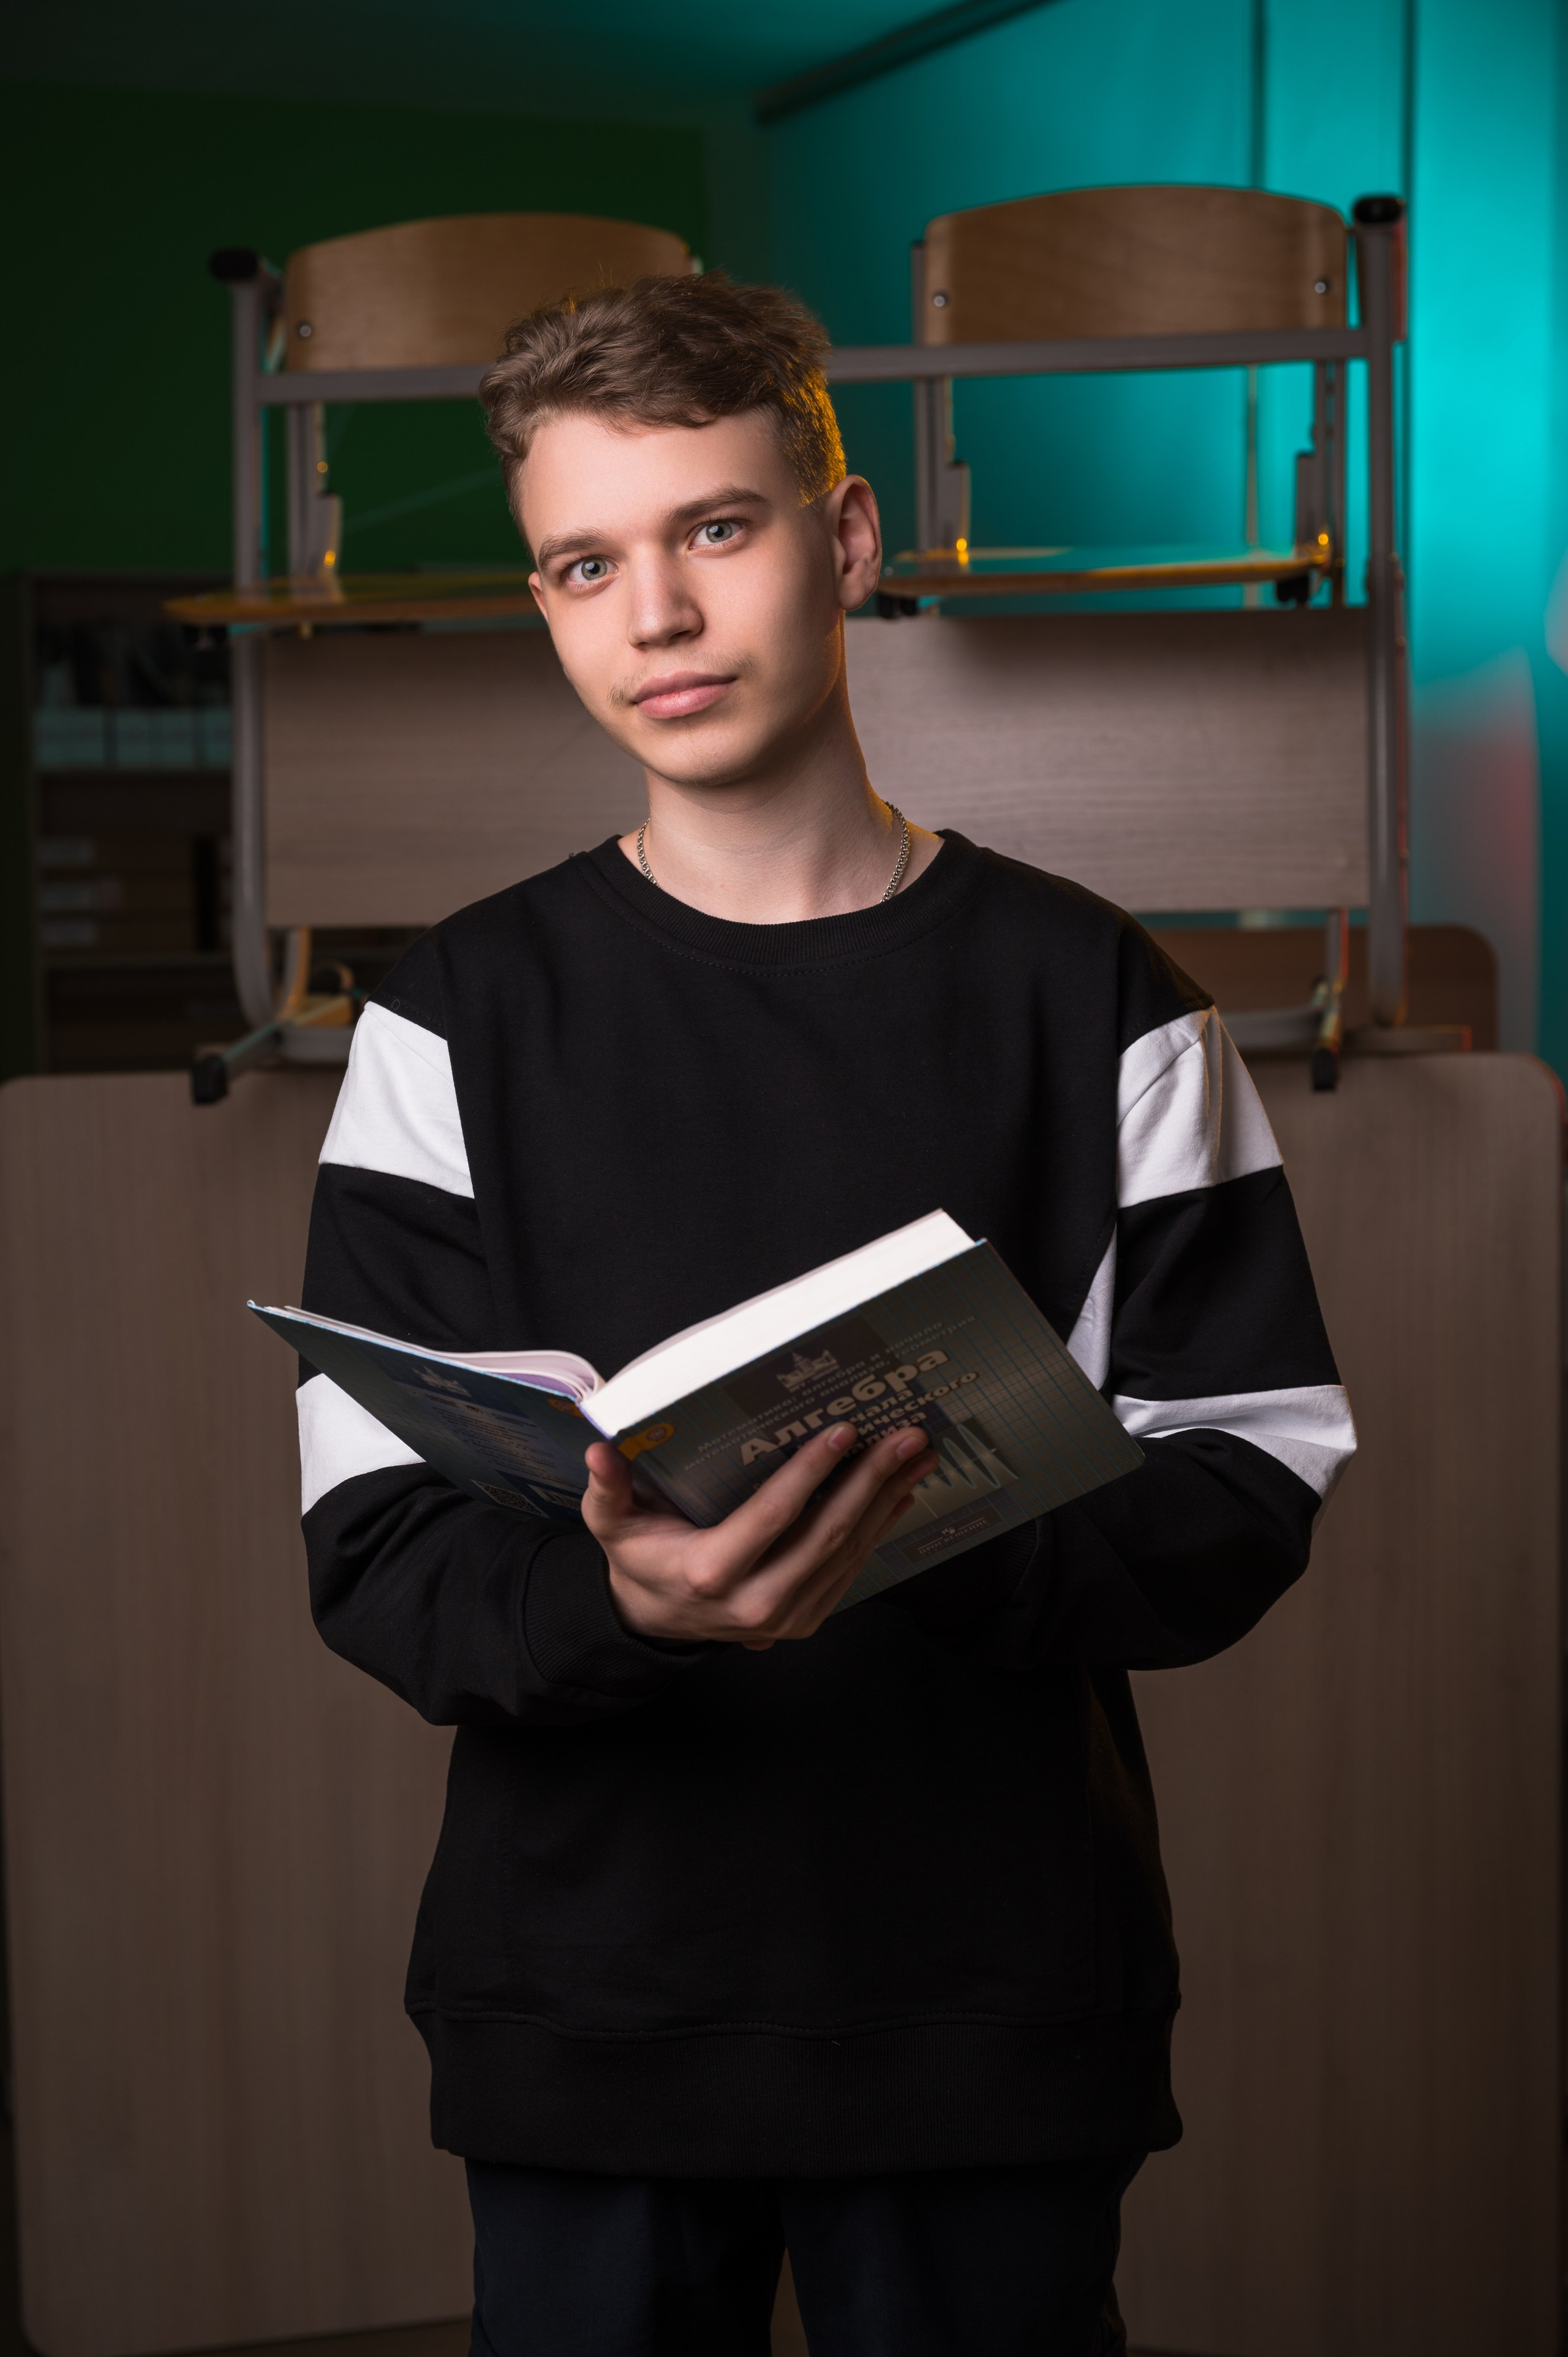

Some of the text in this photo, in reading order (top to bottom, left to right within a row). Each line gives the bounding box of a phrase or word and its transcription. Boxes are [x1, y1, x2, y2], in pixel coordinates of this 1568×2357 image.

[802, 1360, 865, 1397] алгебра
[885, 1321, 943, 1354] начала
[684, 1397, 815, 1471] математического
[739, 1349, 949, 1467] Алгебра
